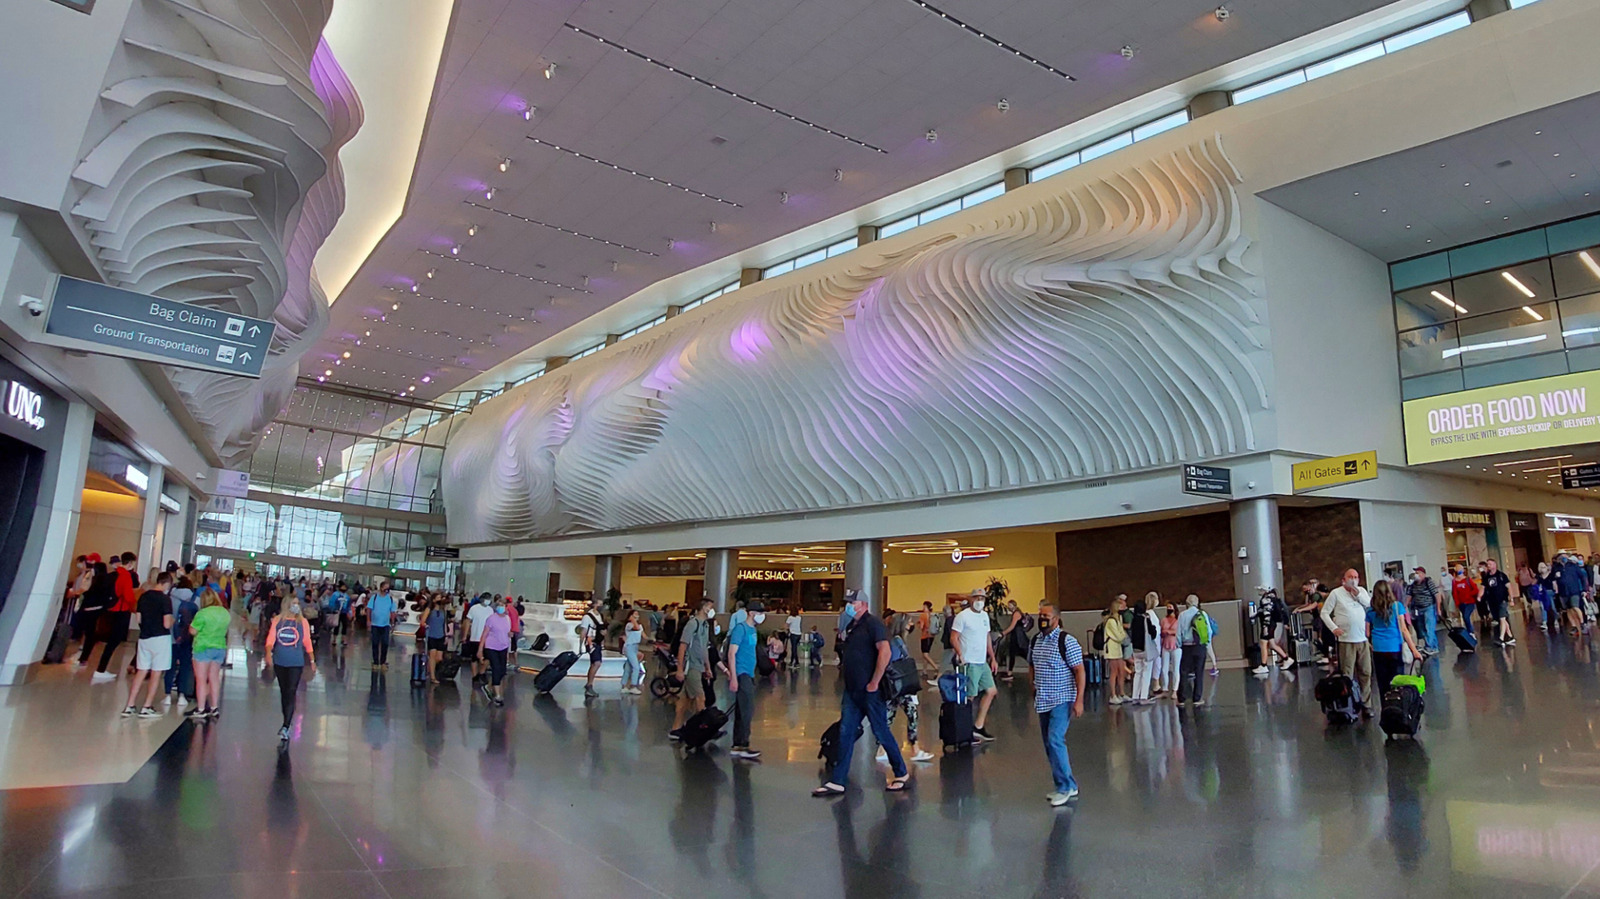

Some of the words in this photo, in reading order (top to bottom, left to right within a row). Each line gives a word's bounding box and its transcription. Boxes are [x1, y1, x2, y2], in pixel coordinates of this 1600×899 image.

[149, 303, 176, 321] Bag
[178, 310, 217, 328] Claim
[93, 323, 135, 340] Ground
[138, 332, 210, 356] Transportation
[1427, 402, 1486, 434] ORDER
[1487, 395, 1537, 425] FOOD
[1539, 387, 1586, 418] NOW
[1430, 435, 1453, 446] BYPASS
[1454, 433, 1465, 442] THE
[1466, 431, 1480, 442] LINE
[1481, 429, 1497, 439] WITH
[1498, 425, 1527, 437] EXPRESS
[1527, 422, 1551, 433] PICKUP
[1553, 420, 1562, 429] OR
[1563, 416, 1596, 428] DELIVERY
[1299, 469, 1312, 481] All
[1314, 466, 1341, 479] Gates
[764, 570, 795, 581] SHACK
